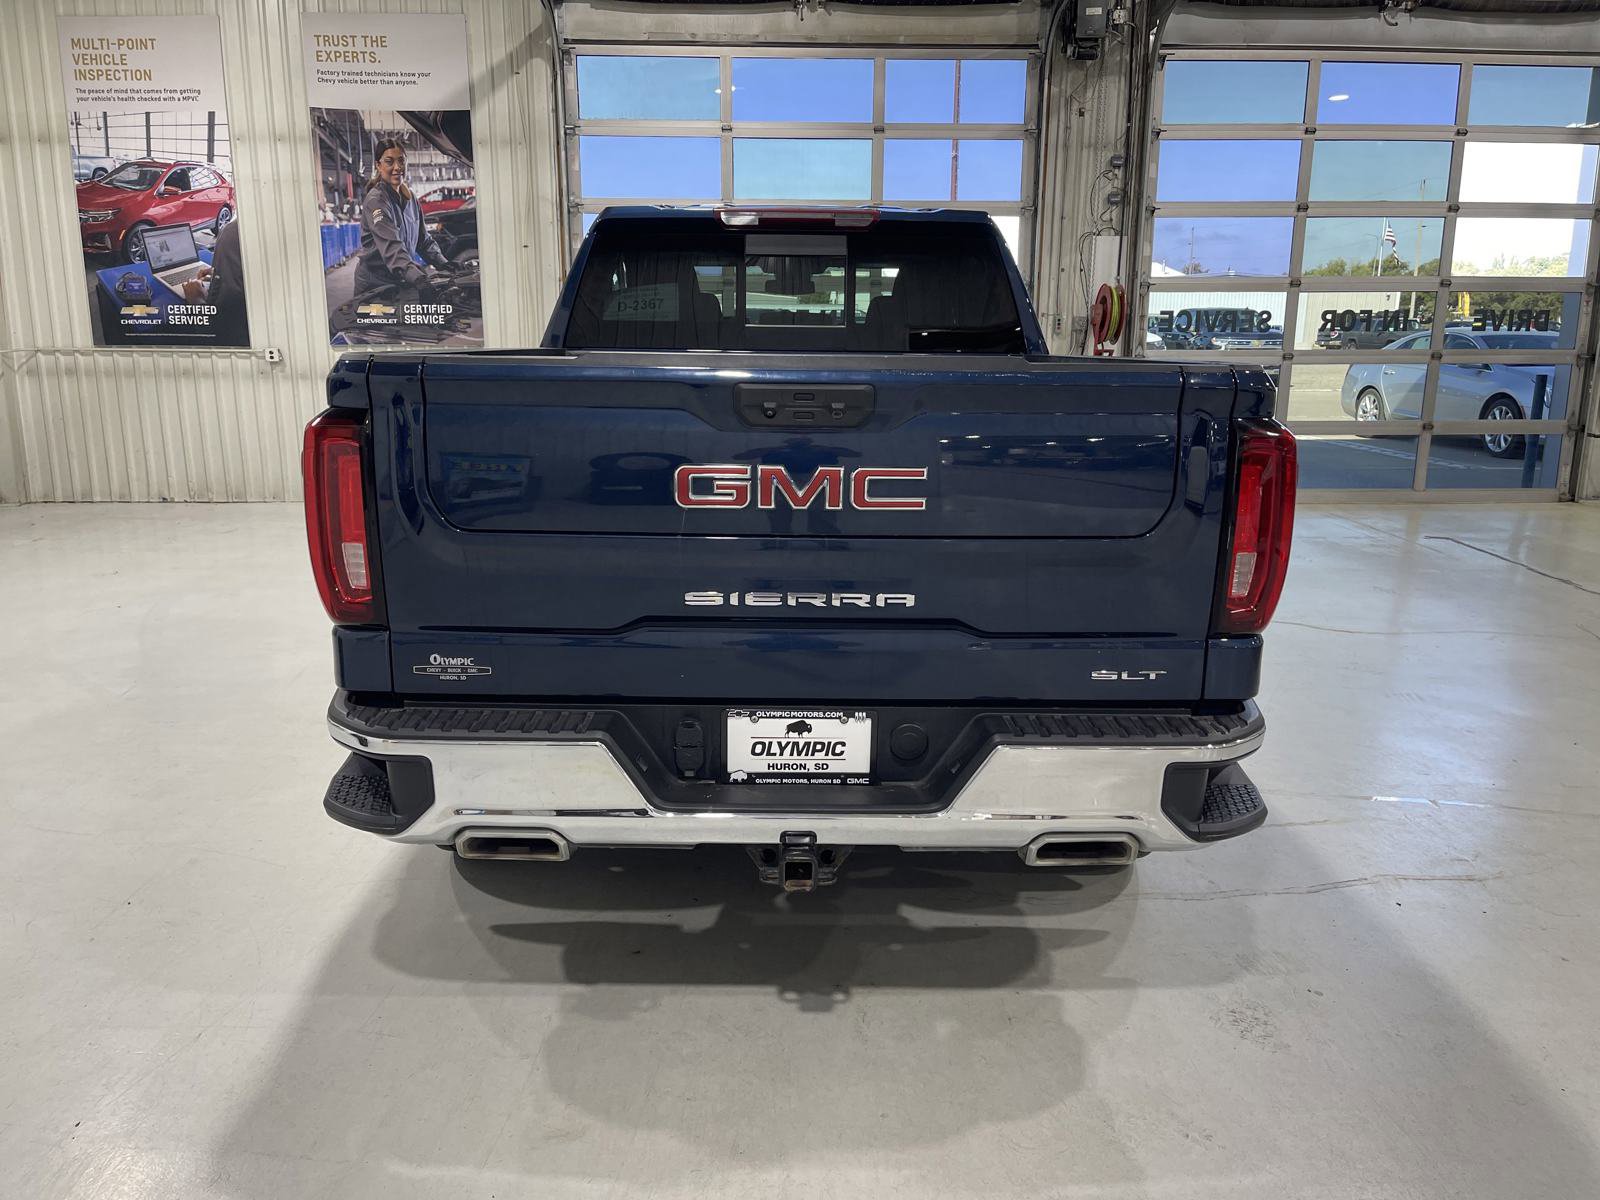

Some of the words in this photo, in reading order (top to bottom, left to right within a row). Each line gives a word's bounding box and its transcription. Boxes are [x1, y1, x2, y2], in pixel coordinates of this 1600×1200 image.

[71, 38, 156, 50] MULTI-POINT
[314, 35, 357, 48] TRUST
[361, 36, 387, 48] THE
[72, 53, 128, 66] VEHICLE
[316, 51, 381, 63] EXPERTS.
[74, 69, 152, 81] INSPECTION
[316, 69, 340, 77] Factory
[168, 305, 217, 315] CERTIFIED
[403, 304, 453, 314] CERTIFIED
[168, 315, 210, 325] SERVICE
[404, 314, 445, 325] SERVICE
[674, 464, 928, 510] GMC
[684, 591, 916, 607] SIERRA
[1091, 670, 1168, 680] SLT
[750, 741, 847, 757] OLYMPIC
[767, 763, 810, 771] HURON,
